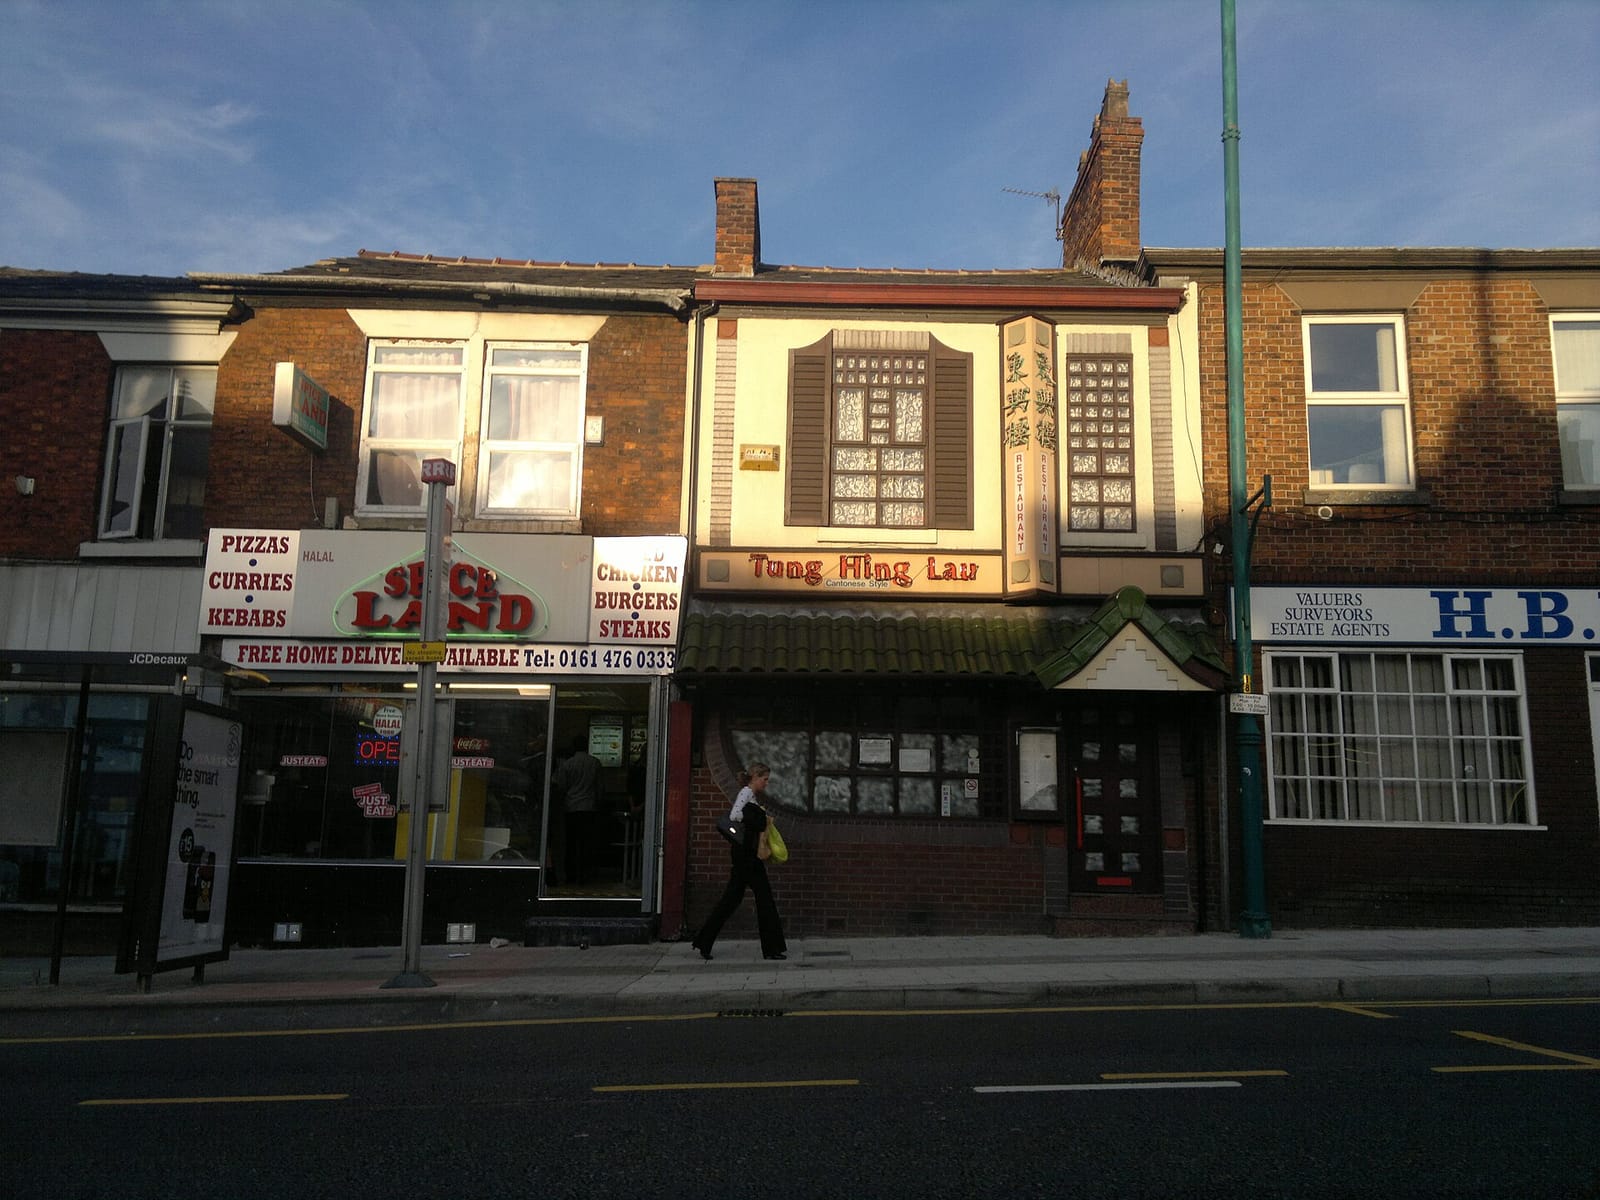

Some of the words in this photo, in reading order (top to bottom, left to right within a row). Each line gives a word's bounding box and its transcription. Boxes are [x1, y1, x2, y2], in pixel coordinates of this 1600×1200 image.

[1016, 454, 1024, 551] RESTAURANT
[221, 535, 290, 554] PIZZAS
[303, 551, 334, 562] HALAL
[749, 553, 823, 586] Tung
[839, 553, 912, 588] Hing
[927, 557, 979, 581] Lau
[209, 572, 293, 591] CURRIES
[384, 561, 498, 600] SPCE
[825, 579, 865, 587] Cantonese
[869, 579, 888, 588] Style
[595, 591, 678, 610] BURGERS
[1296, 593, 1362, 606] VALUERS
[208, 608, 287, 628] KEBABS
[1285, 608, 1373, 621] SURVEYORS
[1430, 591, 1600, 639] H.B.
[599, 619, 671, 638] STEAKS
[1271, 623, 1324, 636] ESTATE
[1331, 623, 1390, 637] AGENTS
[130, 654, 187, 664] JCDecaux
[237, 645, 282, 663] FREE
[286, 646, 337, 664] HOME
[524, 649, 555, 667] Tel:
[559, 650, 598, 668] 0161
[603, 650, 632, 668] 476
[636, 651, 675, 669] 0333
[375, 719, 400, 729] HALAL
[179, 741, 193, 760] Do
[360, 741, 400, 760] OPE
[281, 756, 303, 765] JUST
[304, 757, 320, 766] EAT
[452, 758, 470, 766] UST
[471, 758, 486, 767] EAT
[177, 762, 192, 782] the
[194, 768, 219, 786] smart
[360, 795, 388, 805] JUST
[366, 805, 387, 815] EAT
